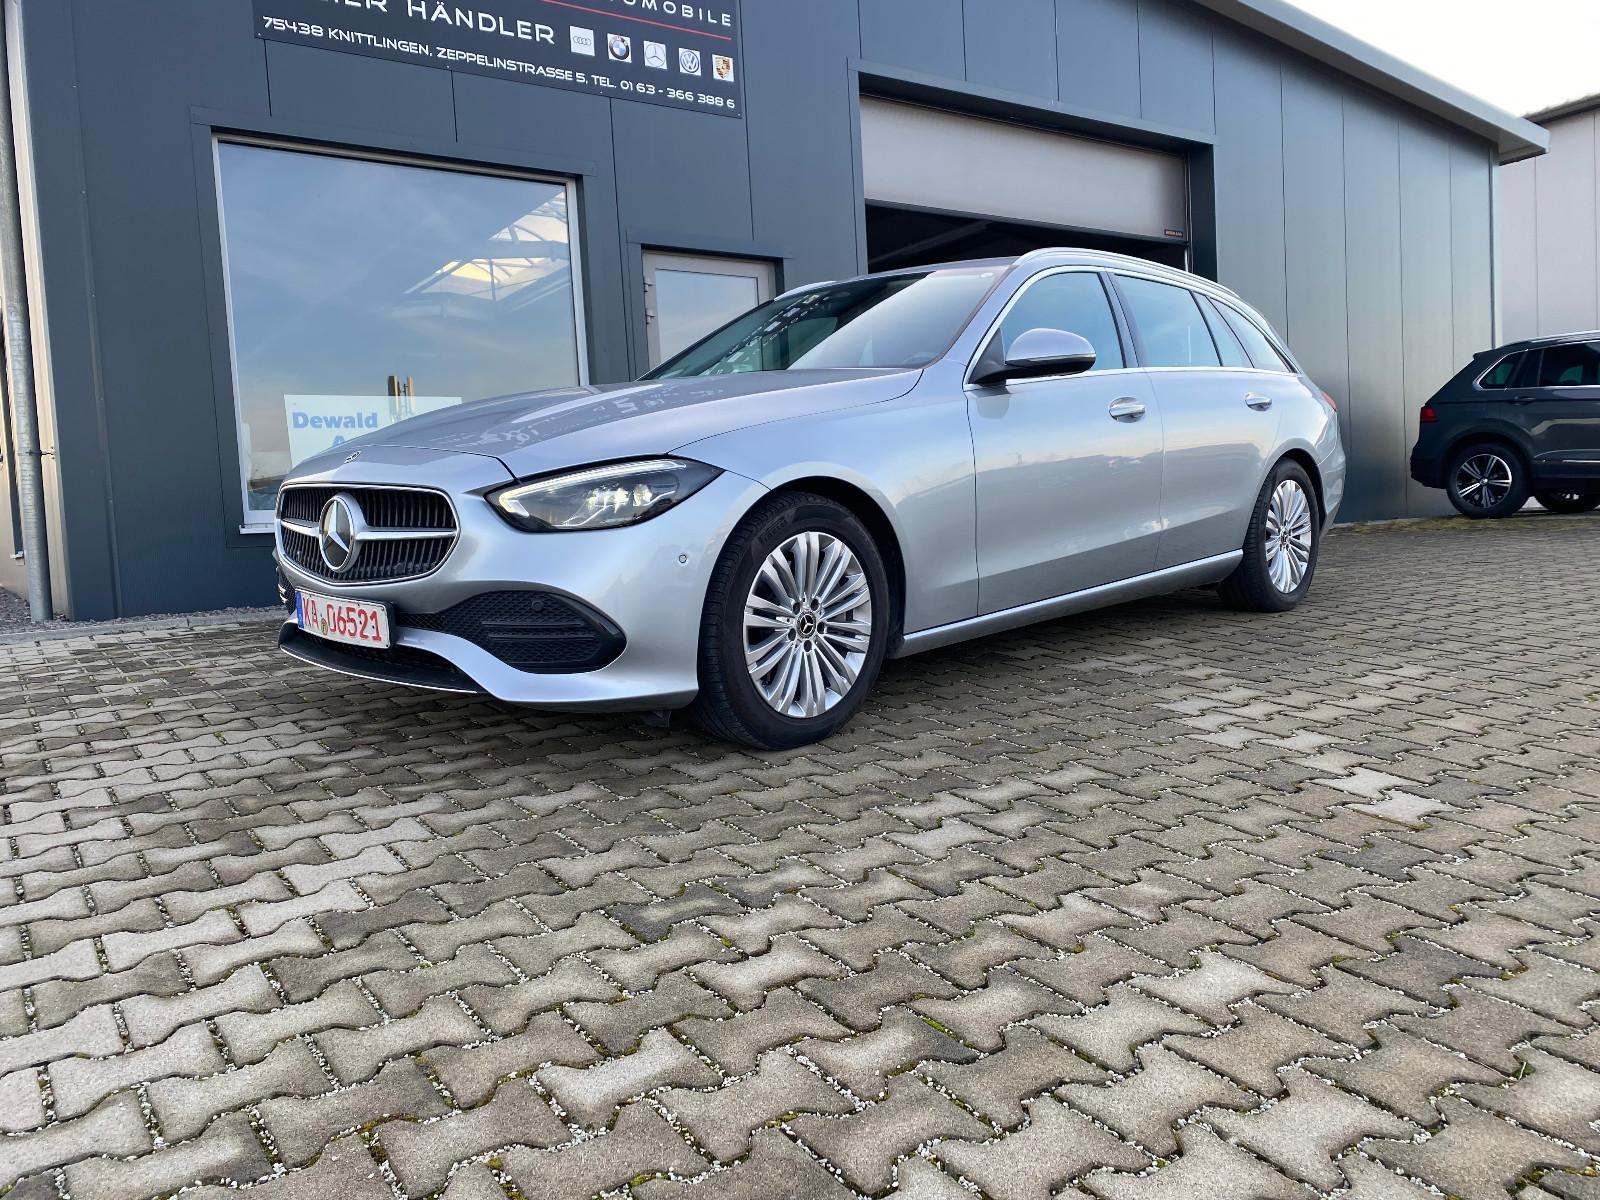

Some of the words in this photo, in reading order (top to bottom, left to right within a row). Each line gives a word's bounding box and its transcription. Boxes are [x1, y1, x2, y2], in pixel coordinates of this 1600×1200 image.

[407, 0, 555, 44] HÄNDLER
[262, 15, 324, 37] 75438
[328, 28, 433, 57] KNITTLINGEN,
[436, 46, 574, 81] ZEPPELINSTRASSE
[575, 71, 588, 85] 5,
[591, 75, 617, 88] TEL.
[666, 87, 694, 102] 366
[697, 93, 724, 107] 388
[726, 98, 735, 109] 6
[292, 412, 378, 428] Dewald
[326, 604, 382, 641] 06521
